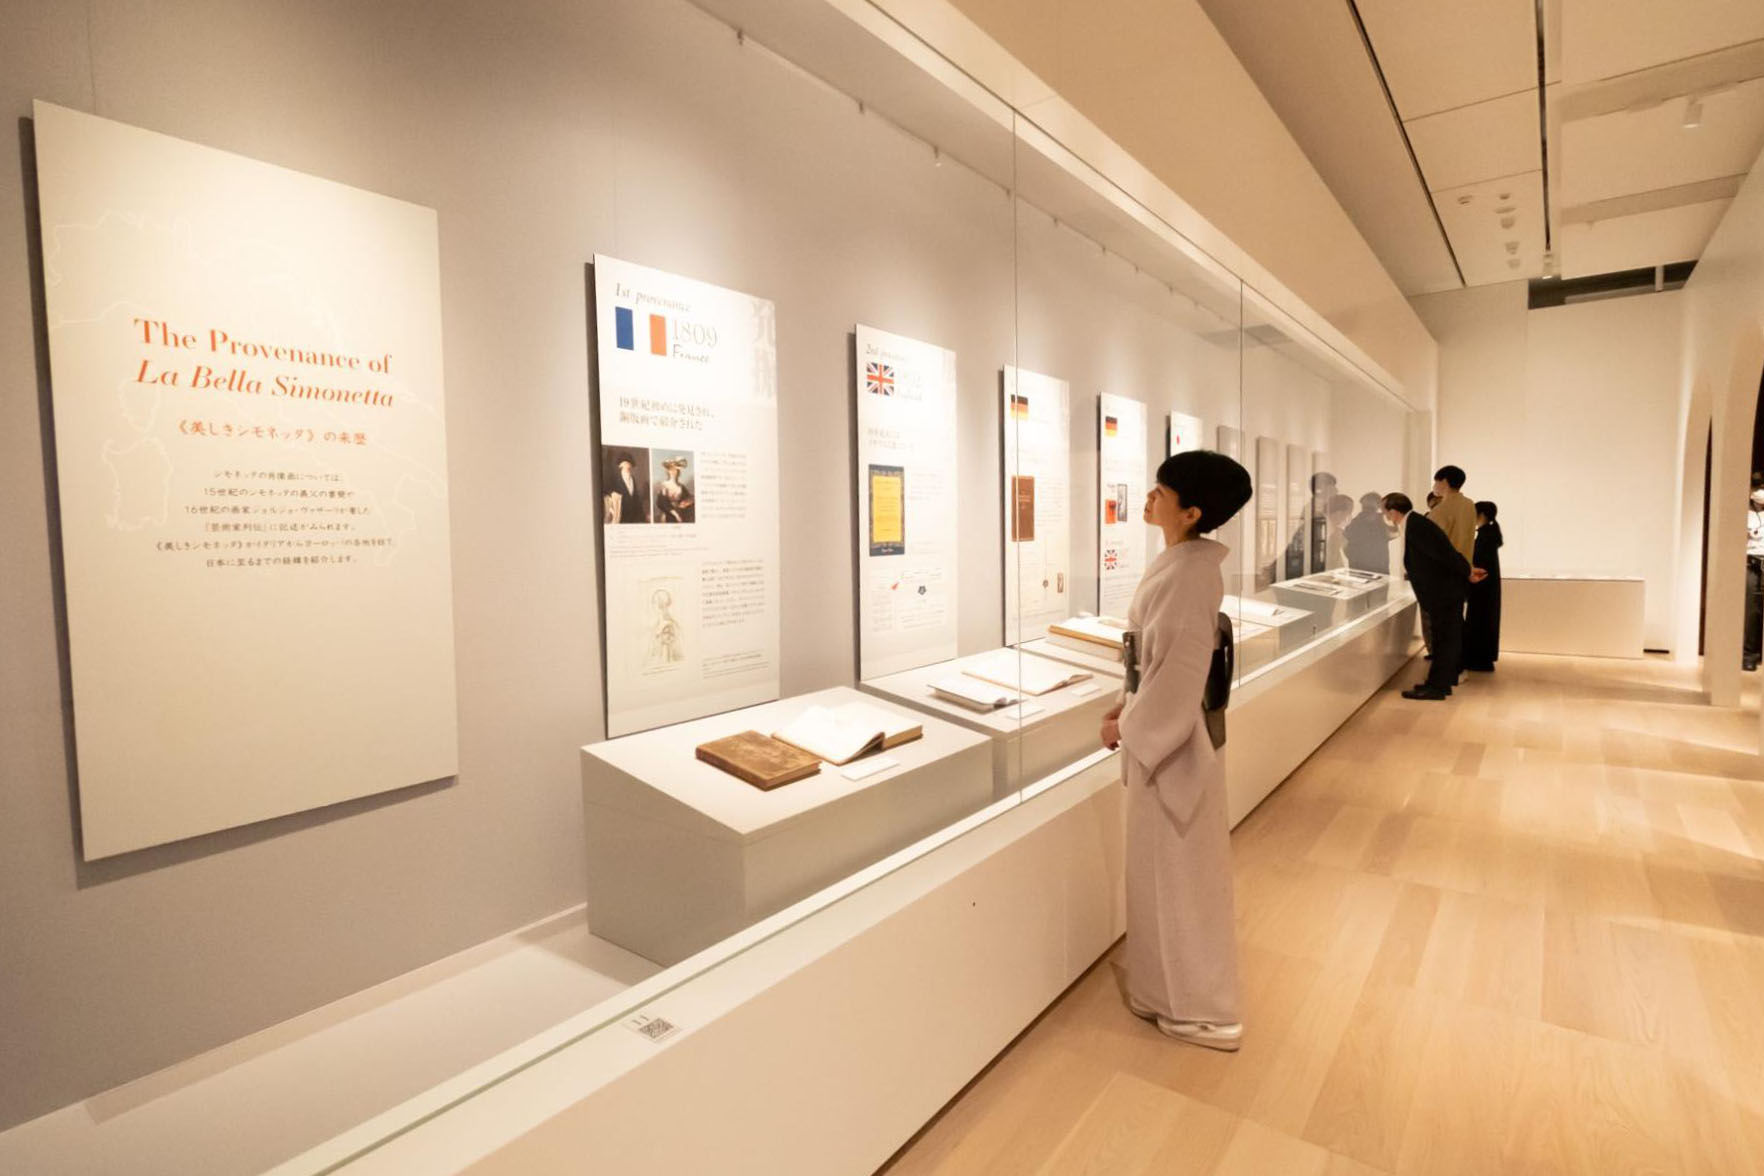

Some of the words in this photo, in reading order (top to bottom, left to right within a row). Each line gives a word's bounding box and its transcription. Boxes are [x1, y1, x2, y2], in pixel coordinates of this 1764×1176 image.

[133, 318, 197, 350] The
[209, 329, 360, 370] Provenance
[368, 353, 393, 375] of
[672, 319, 719, 348] 1809
[135, 359, 179, 387] La
[191, 365, 262, 395] Bella
[271, 375, 395, 408] Simonetta
